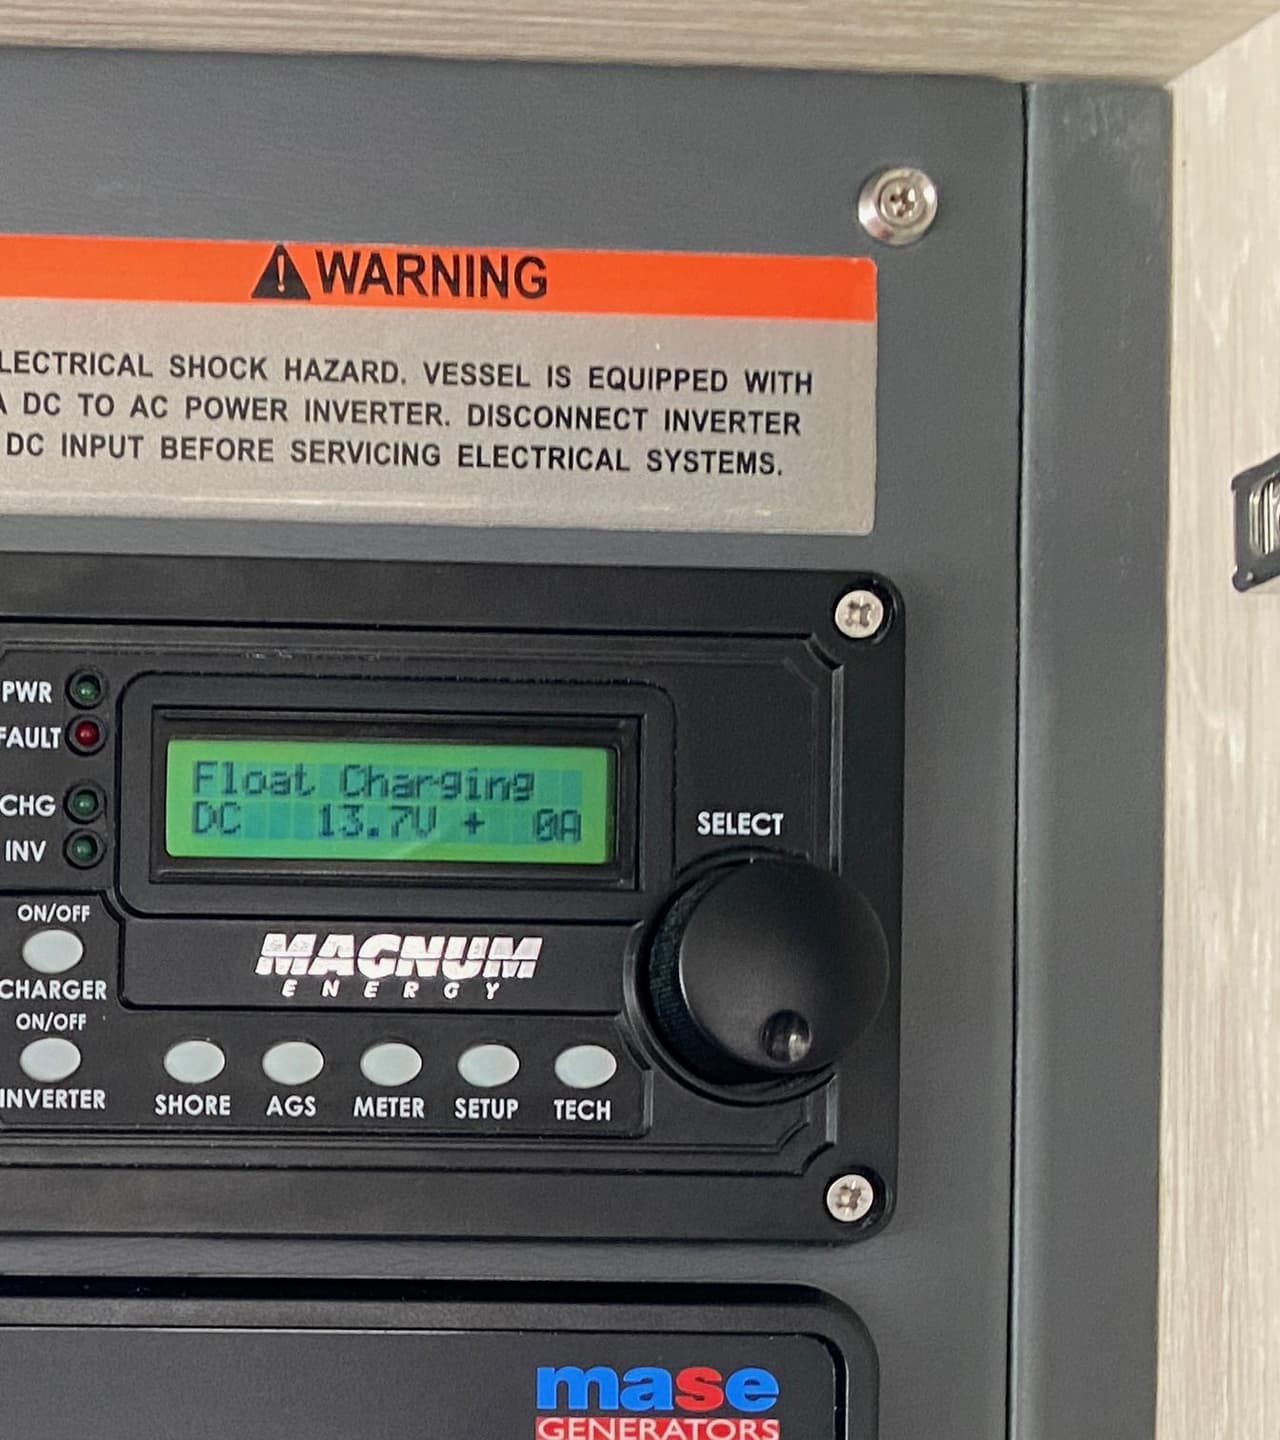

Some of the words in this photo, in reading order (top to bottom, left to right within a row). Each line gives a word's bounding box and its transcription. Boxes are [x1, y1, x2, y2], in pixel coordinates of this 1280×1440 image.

[315, 249, 548, 300] WARNING
[169, 354, 268, 381] SHOCK
[284, 357, 407, 385] HAZARD.
[423, 361, 531, 388] VESSEL
[547, 364, 571, 389] IS
[588, 366, 728, 393] EQUIPPED
[744, 369, 813, 395] WITH
[23, 391, 61, 417] DC
[77, 392, 115, 418] TO
[129, 394, 168, 419] AC
[185, 395, 288, 423] POWER
[305, 399, 451, 427] INVERTER.
[467, 403, 649, 432] DISCONNECT
[664, 408, 801, 436] INVERTER
[6, 431, 44, 457] DC
[61, 432, 145, 460] INPUT
[160, 435, 274, 463] BEFORE
[290, 439, 441, 468] SERVICING
[457, 443, 631, 472] ELECTRICAL
[646, 448, 783, 477] SYSTEMS.
[2, 680, 52, 704] PWR
[191, 761, 313, 797] Float
[339, 763, 537, 801] Charging
[190, 801, 242, 836] DC
[317, 804, 437, 838] 13.7V
[697, 811, 784, 836] SELECT
[5, 839, 47, 862] INV
[17, 902, 91, 923] ON/OFF
[254, 933, 543, 979] MAGNUM
[281, 978, 500, 1000] ENERGY
[0, 1088, 106, 1110] INVERTER
[155, 1094, 231, 1116] SHORE
[266, 1095, 316, 1117] AGS
[353, 1096, 425, 1119] METER
[454, 1097, 519, 1120] SETUP
[553, 1099, 611, 1121] TECH
[535, 1364, 781, 1413] mase
